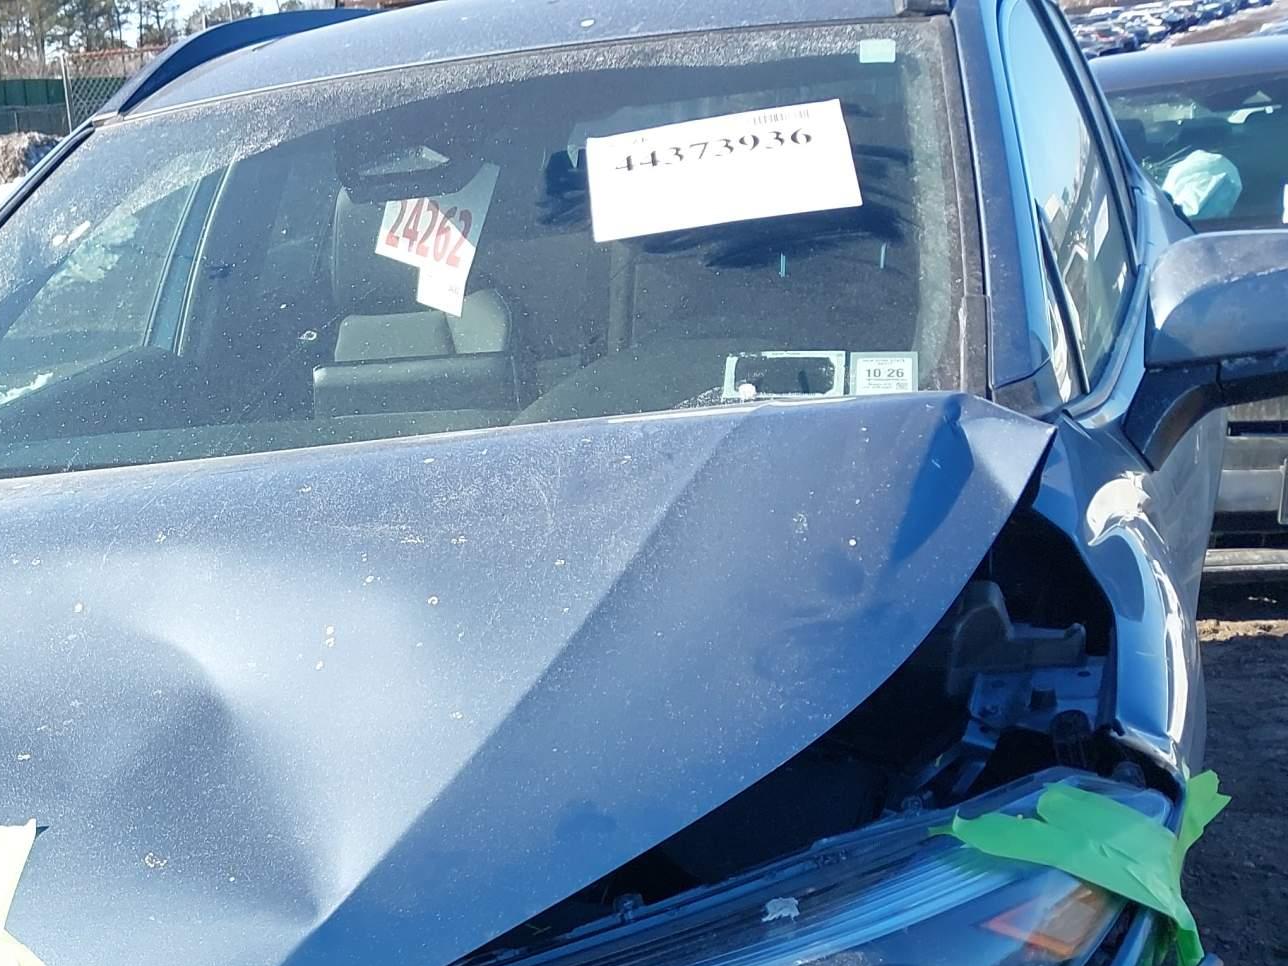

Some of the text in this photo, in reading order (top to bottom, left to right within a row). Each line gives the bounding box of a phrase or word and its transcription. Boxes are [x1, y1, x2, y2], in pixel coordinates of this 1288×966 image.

[614, 128, 812, 171] 44373936
[385, 198, 473, 267] 24262
[866, 368, 904, 378] 10 26
